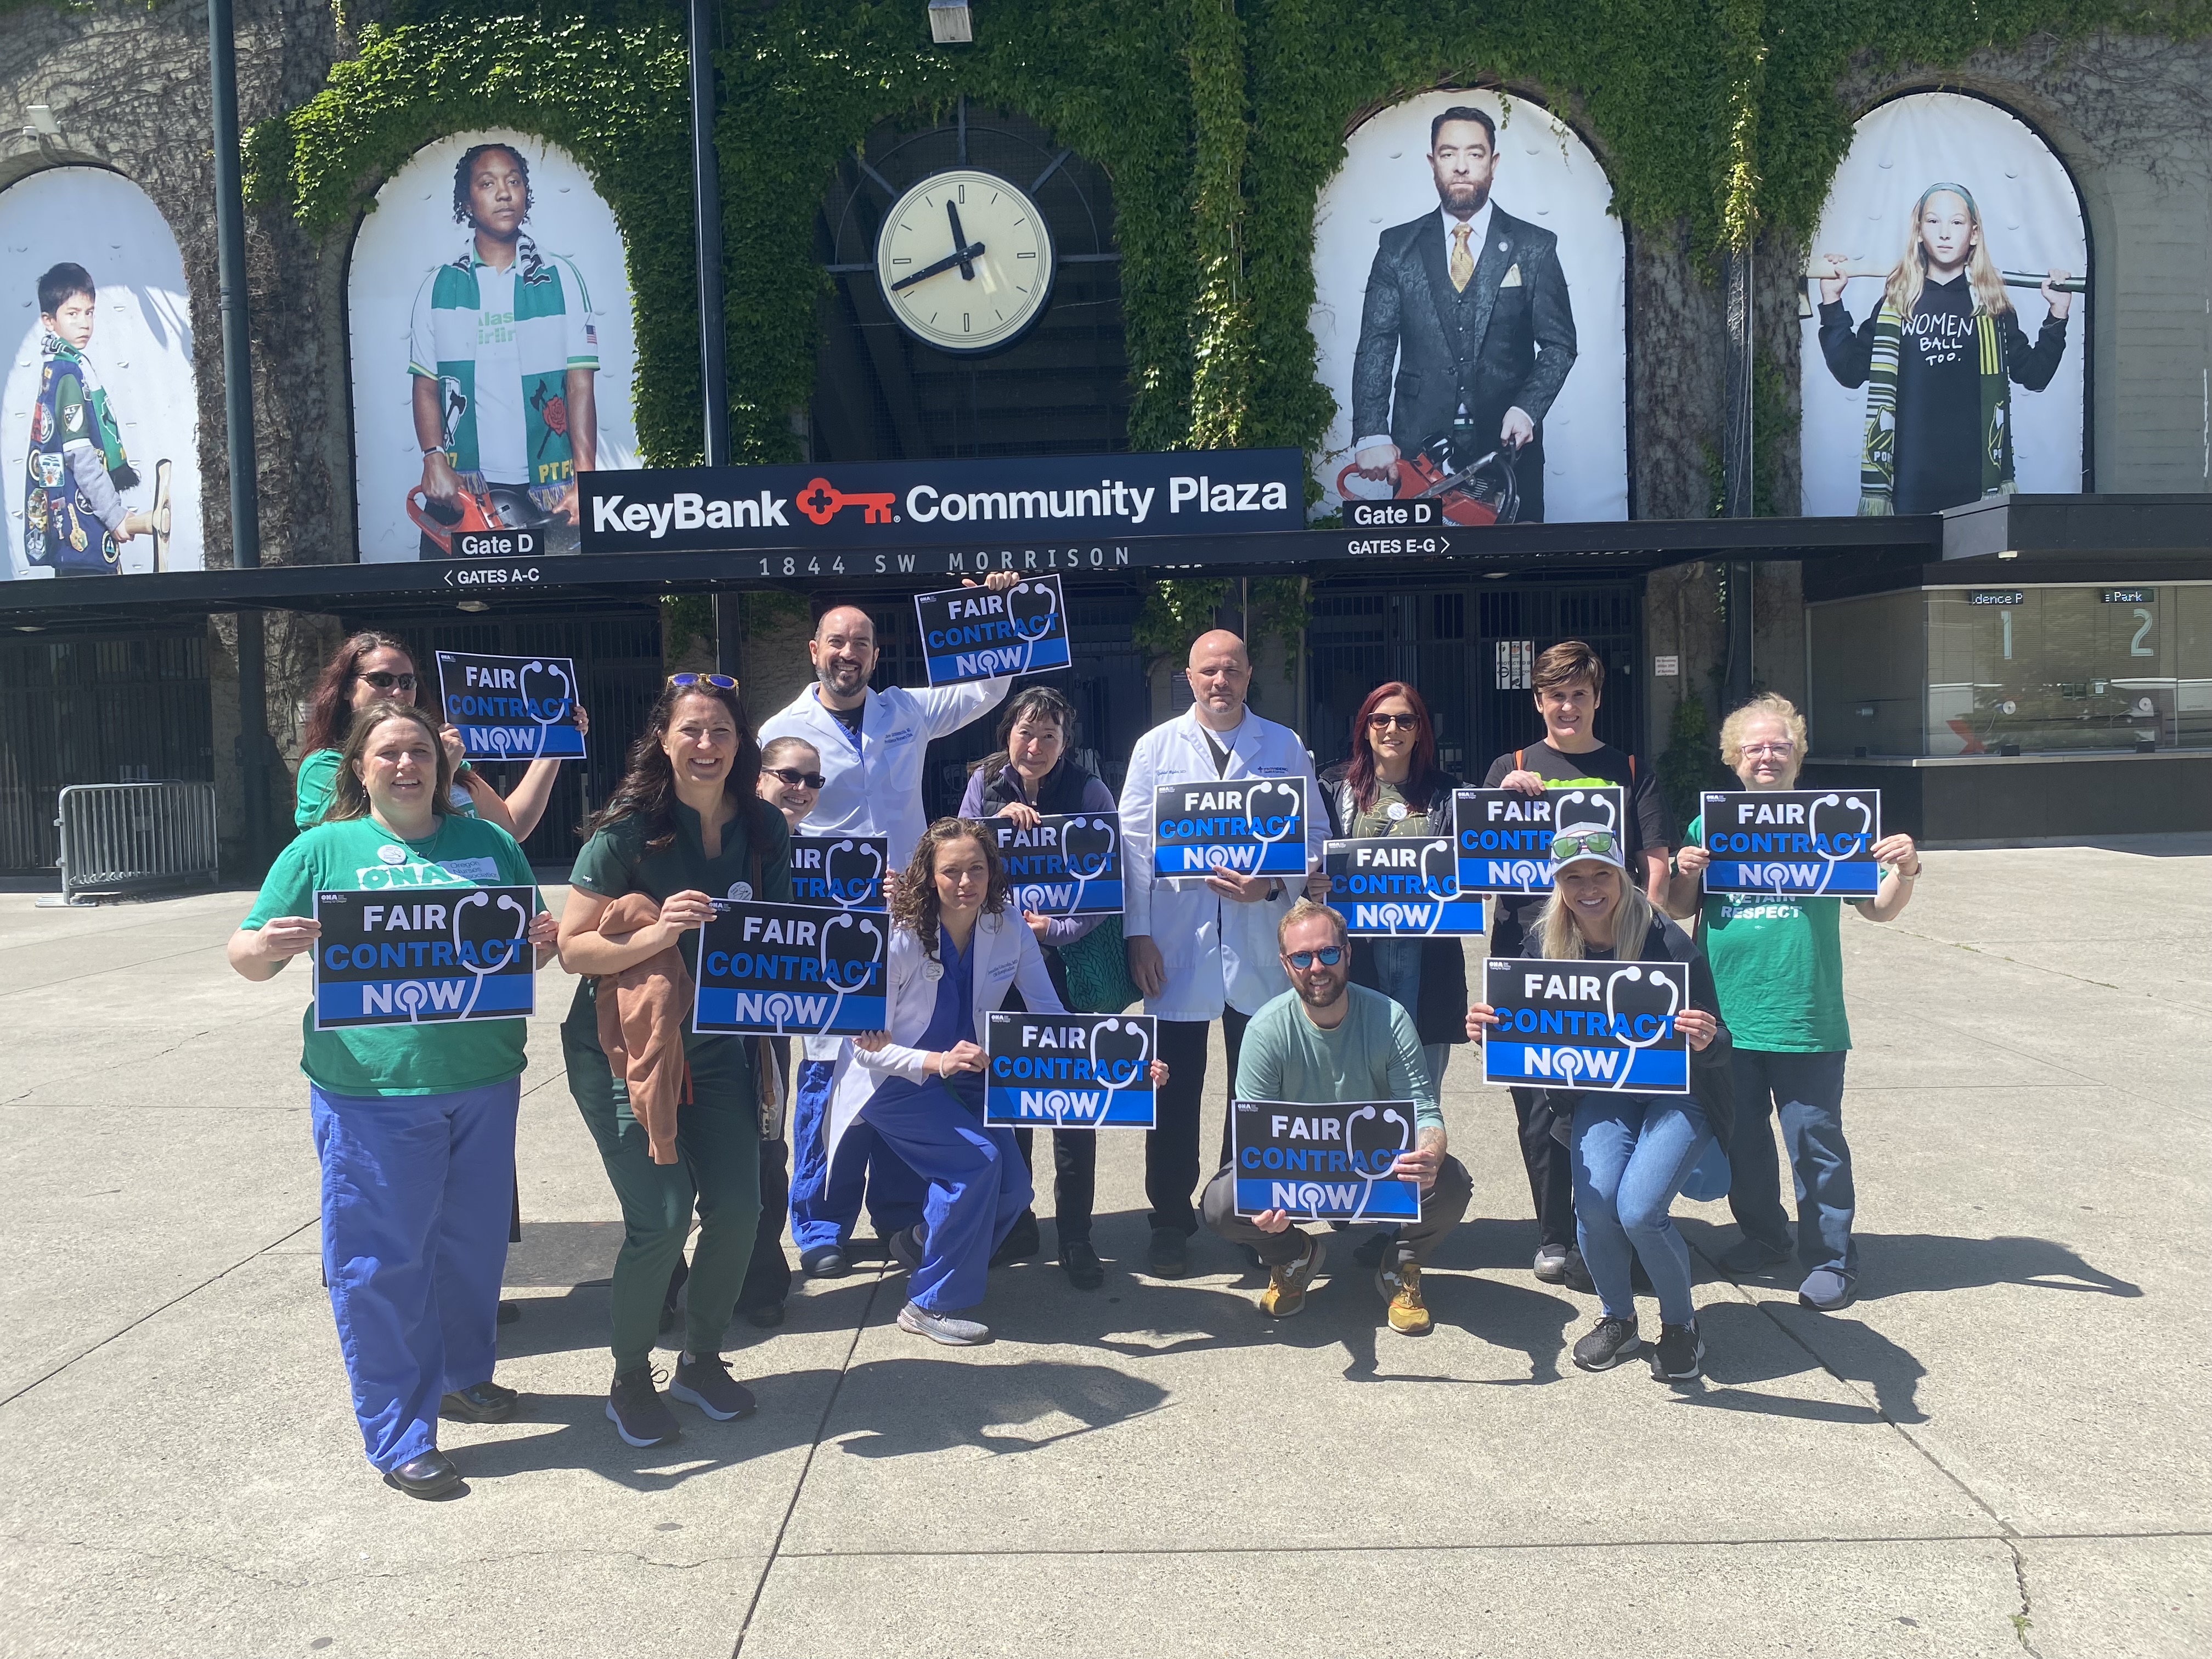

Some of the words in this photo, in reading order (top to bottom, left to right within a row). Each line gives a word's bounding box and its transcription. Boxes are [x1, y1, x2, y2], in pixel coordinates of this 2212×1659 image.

[1901, 312, 1973, 338] WOMEN
[1920, 337, 1963, 352] BALL
[1925, 352, 1961, 366] TOO.
[592, 490, 789, 539] KeyBank
[907, 478, 1155, 525] Community
[1170, 476, 1286, 514] Plaza
[1354, 505, 1408, 525] Gate
[1415, 504, 1431, 523] D
[462, 535, 512, 555] Gate
[517, 533, 533, 552] D
[1348, 539, 1402, 555] GATES
[1406, 538, 1435, 553] E-G
[760, 556, 845, 577] 1844
[876, 554, 916, 574] SW
[949, 546, 1131, 572] MORRISON
[458, 569, 507, 584] GATES
[511, 567, 540, 582] A-C
[948, 595, 1003, 620] FAIR
[1975, 593, 2012, 604] dence
[2114, 591, 2142, 602] Park
[928, 612, 1059, 648] CONTRACT
[2001, 611, 2012, 659] 1
[2131, 608, 2154, 657] 2
[956, 646, 1023, 676] NOW
[465, 666, 517, 689] FAIR
[448, 694, 573, 718] CONTRACT
[469, 726, 535, 752] NOW
[1185, 791, 1242, 811] FAIR
[1488, 800, 1550, 822] FAIR
[1738, 804, 1804, 825] FAIR
[997, 827, 1057, 848] FAIR
[1159, 816, 1300, 839] CONTRACT
[1709, 833, 1872, 853] CONTRACT
[1000, 852, 1117, 877] NTRACT
[1183, 845, 1255, 870] NOW
[1357, 848, 1417, 867] FAIR
[362, 865, 454, 890] ONA
[793, 877, 883, 898] TRACT
[1331, 874, 1457, 895] CONTRAC
[1738, 863, 1820, 887] NOW
[364, 904, 447, 932] FAIR
[1356, 904, 1431, 927] NOW
[1721, 905, 1803, 919] RESPECT
[743, 916, 816, 946] FAIR
[324, 938, 527, 970] CONTRACT
[707, 951, 882, 985] CONTRACT
[362, 980, 466, 1015] NOW
[1525, 974, 1601, 1001] FAIR
[736, 992, 828, 1025] NOW
[1493, 1007, 1679, 1040] CONTRACT
[1022, 1025, 1086, 1049] FAIR
[993, 1055, 1149, 1082] CONTRACT
[1524, 1047, 1620, 1079] NOW
[1020, 1090, 1100, 1118] NOW
[1272, 1115, 1341, 1141] FAIR
[1272, 1182, 1358, 1210] NOW
